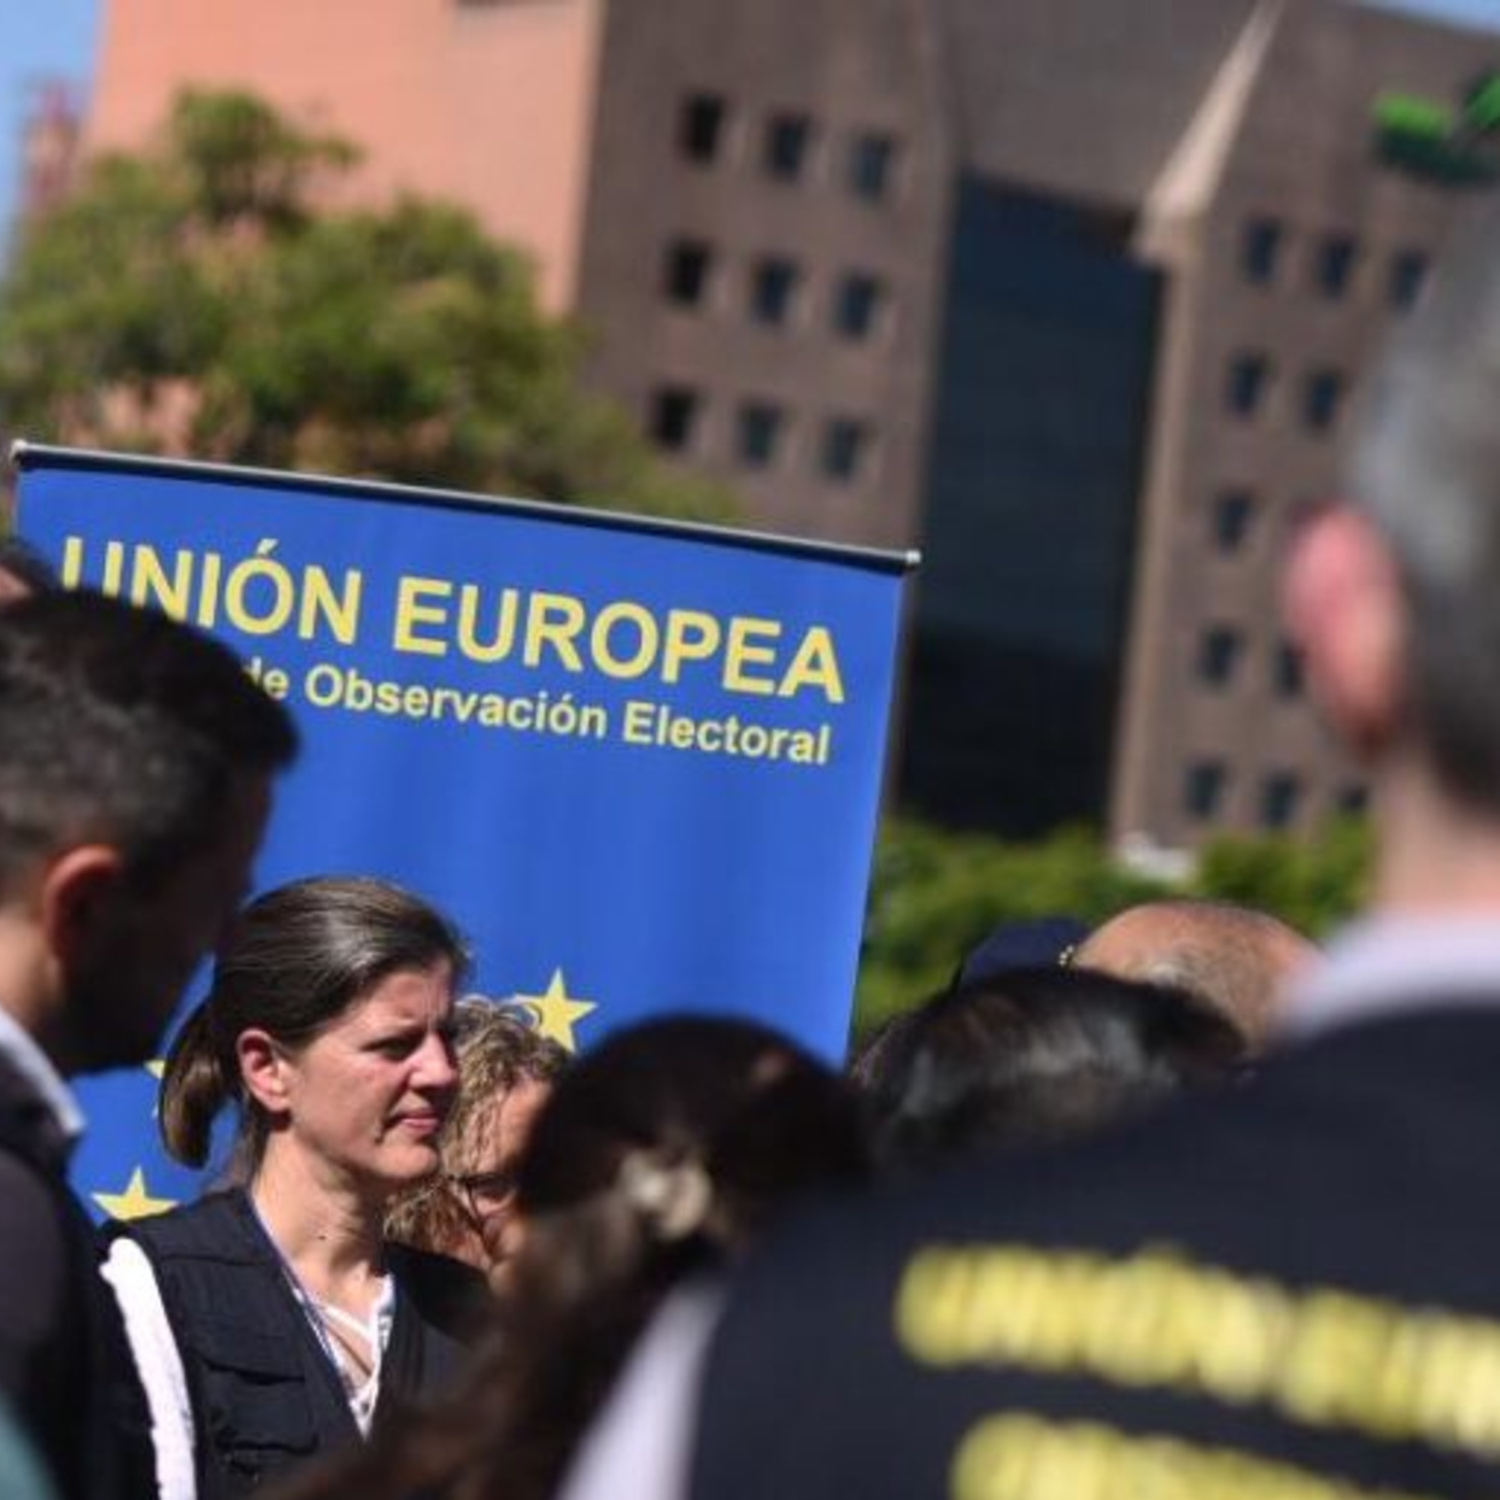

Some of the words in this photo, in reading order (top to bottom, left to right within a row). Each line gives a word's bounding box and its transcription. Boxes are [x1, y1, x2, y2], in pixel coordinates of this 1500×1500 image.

[393, 576, 845, 703] EUROPEA
[304, 664, 606, 738] Observación
[622, 700, 832, 765] Electoral
